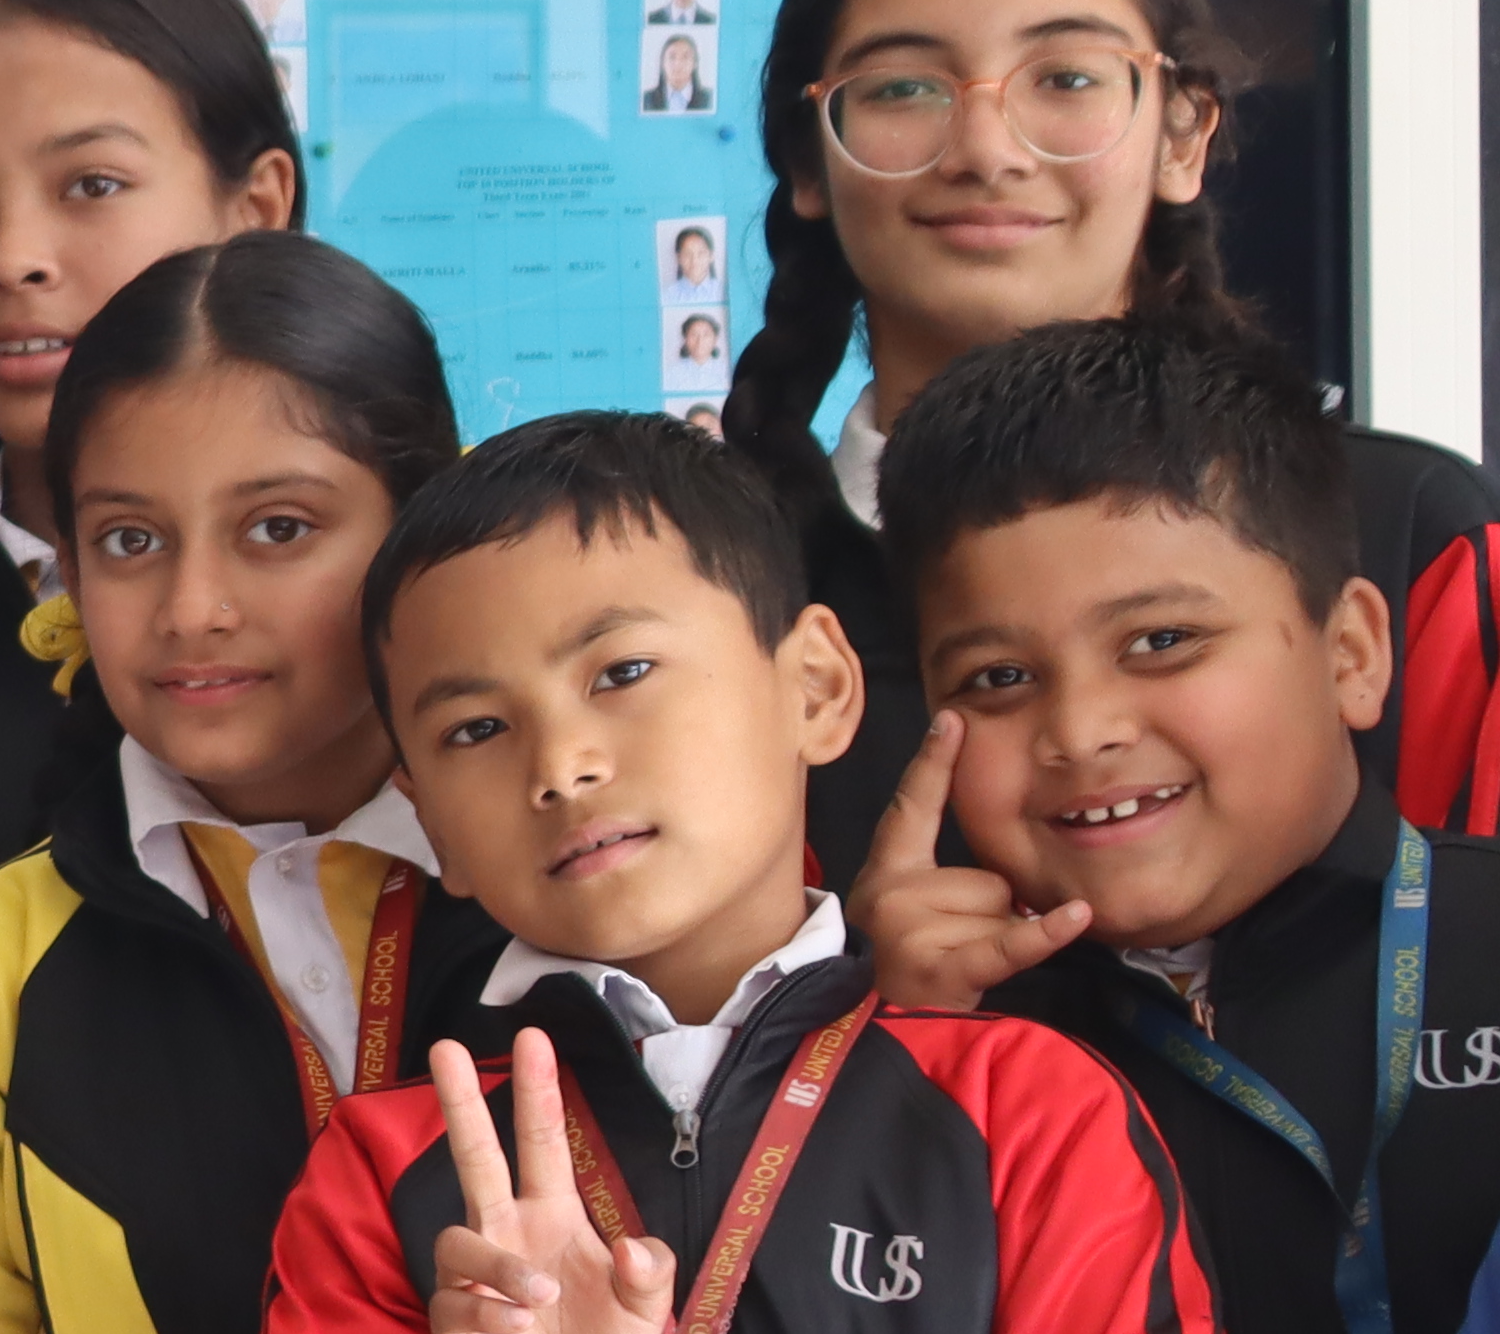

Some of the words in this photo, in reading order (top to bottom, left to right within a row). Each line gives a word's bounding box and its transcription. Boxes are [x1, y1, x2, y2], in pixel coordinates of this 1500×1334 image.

[370, 930, 399, 1006] SCHOOL
[1393, 945, 1421, 1018] SCHOOL
[808, 1027, 844, 1081] UNITED
[585, 1175, 628, 1244] VERSAL
[699, 1224, 753, 1319] UNIVERSAL
[737, 1144, 791, 1217] SCHOOL
